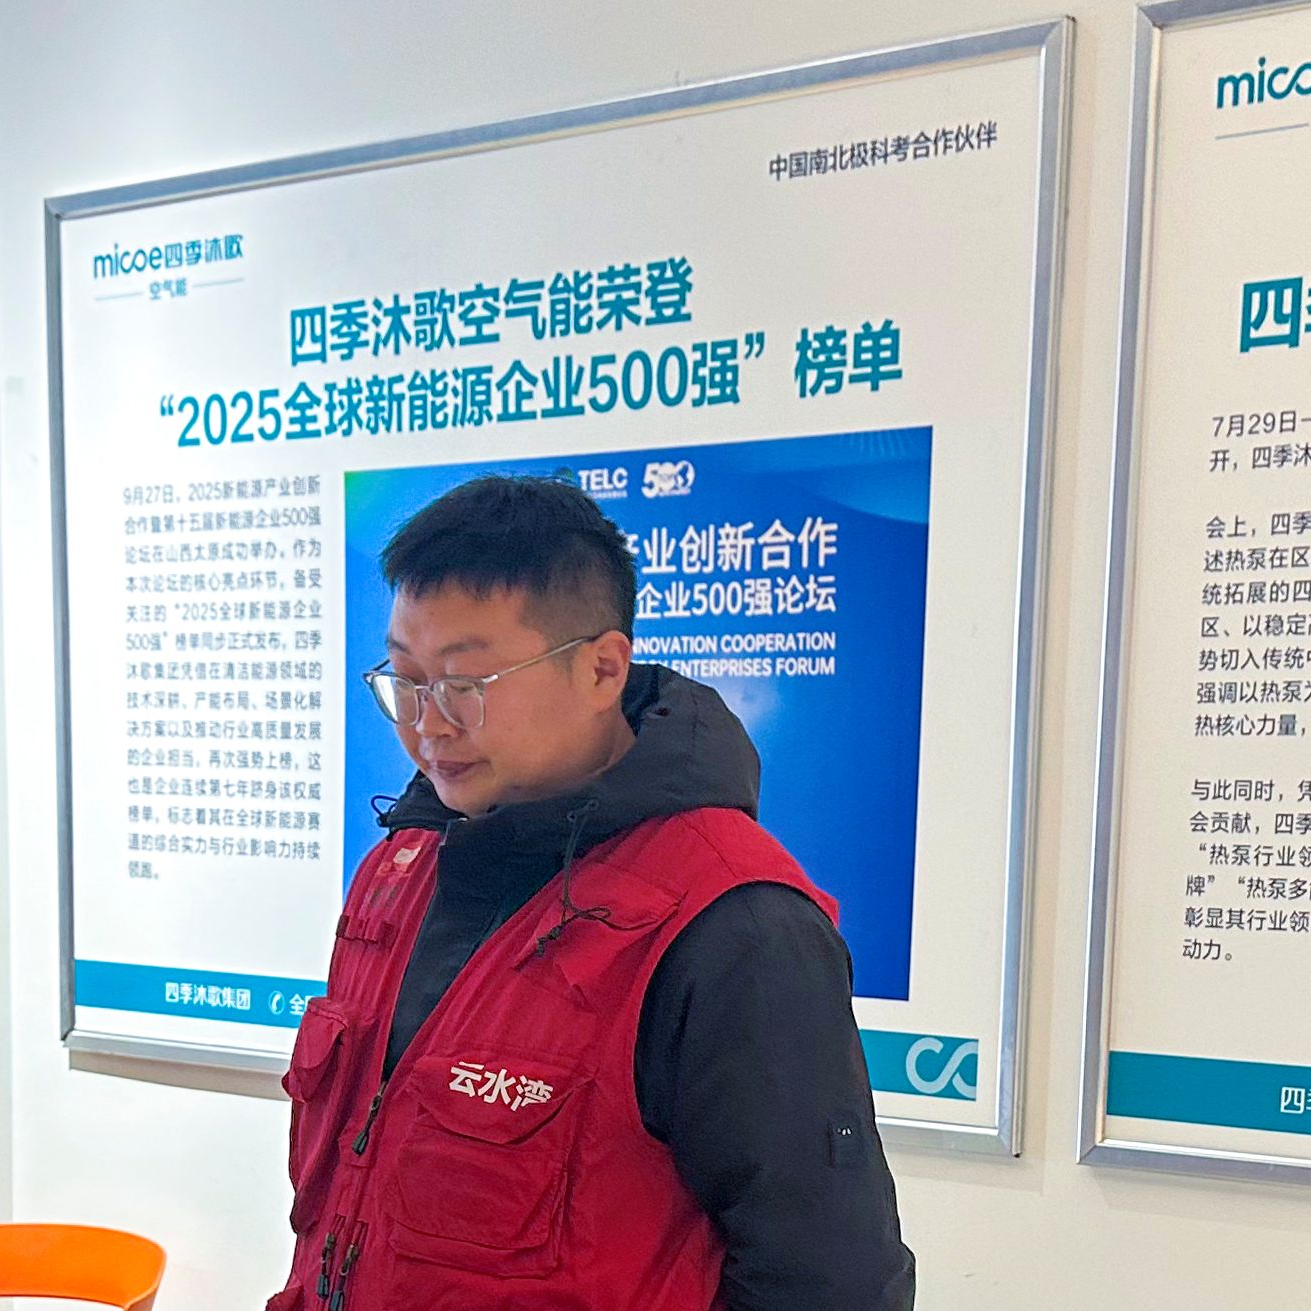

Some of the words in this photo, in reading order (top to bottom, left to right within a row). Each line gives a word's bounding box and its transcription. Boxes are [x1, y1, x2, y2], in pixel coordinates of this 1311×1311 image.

[768, 120, 998, 184] 中国南北极科考合作伙伴
[149, 278, 187, 300] 空气能
[288, 255, 694, 369] 四季沐歌空气能荣登
[578, 467, 628, 491] TELC
[635, 574, 836, 619] 企业500强论坛
[721, 631, 835, 653] COOPERATION
[776, 656, 835, 675] FORUM
[1182, 937, 1234, 963] 动力。
[165, 981, 251, 1010] 四季沐歌集团
[290, 994, 309, 1015] 全
[449, 1061, 554, 1112] 云水湾
